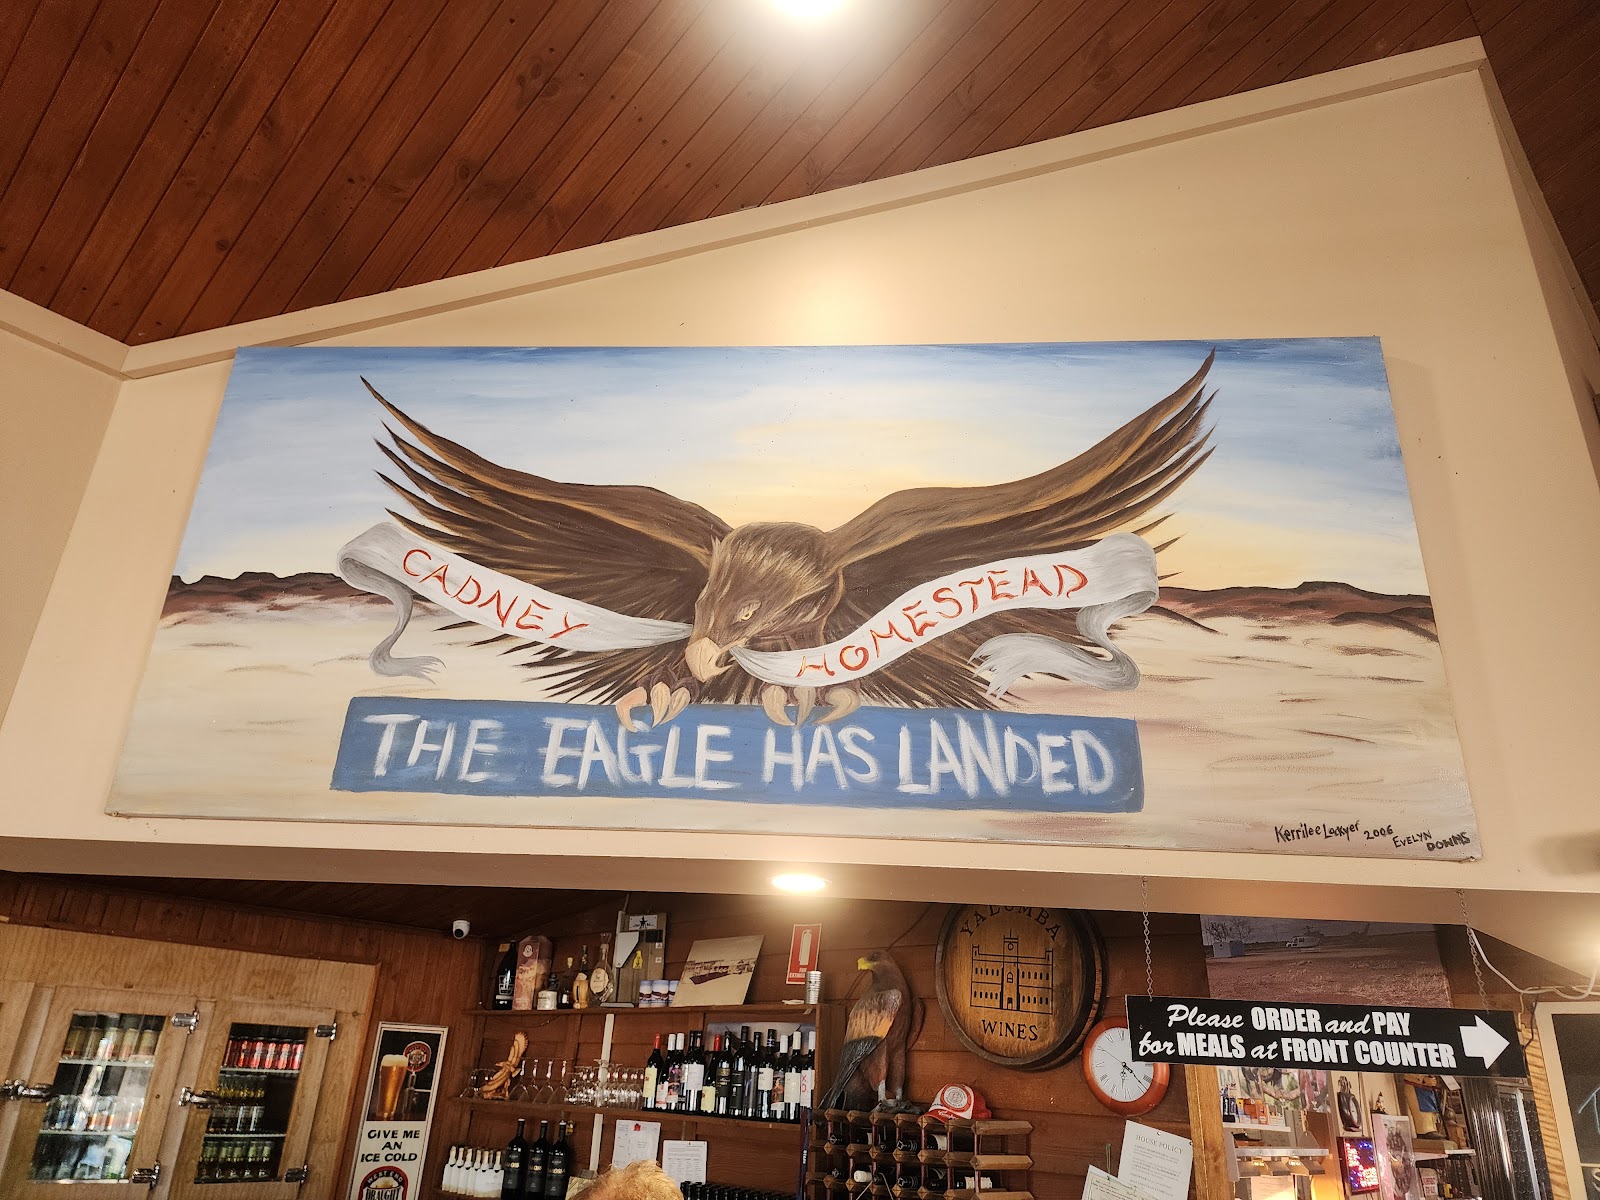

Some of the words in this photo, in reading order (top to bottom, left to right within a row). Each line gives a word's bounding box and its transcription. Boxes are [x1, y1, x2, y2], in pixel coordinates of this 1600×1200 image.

[402, 549, 589, 639] CADNEY
[797, 564, 1088, 677] HOMESTEAD
[363, 714, 502, 783] THE
[538, 717, 741, 790] EAGLE
[763, 725, 881, 791] HAS
[897, 713, 1115, 797] LANDED
[1364, 825, 1394, 840] 2006
[982, 1019, 1038, 1041] WINES
[1167, 1004, 1244, 1029] Please
[1251, 1007, 1322, 1033] ORDER
[1325, 1013, 1371, 1034] and
[1372, 1011, 1410, 1036] PAY
[1139, 1031, 1175, 1056] for
[1176, 1032, 1246, 1059] MEALS
[1250, 1041, 1279, 1060] at
[1281, 1038, 1349, 1064] FRONT
[1353, 1040, 1457, 1068] COUNTER
[367, 1129, 398, 1139] GIVE
[402, 1130, 420, 1139] ME
[1136, 1134, 1157, 1146] HOUSE
[1159, 1142, 1183, 1154] POLICY
[381, 1141, 402, 1150] AN
[360, 1153, 381, 1162] ICE
[384, 1152, 418, 1162] COLD
